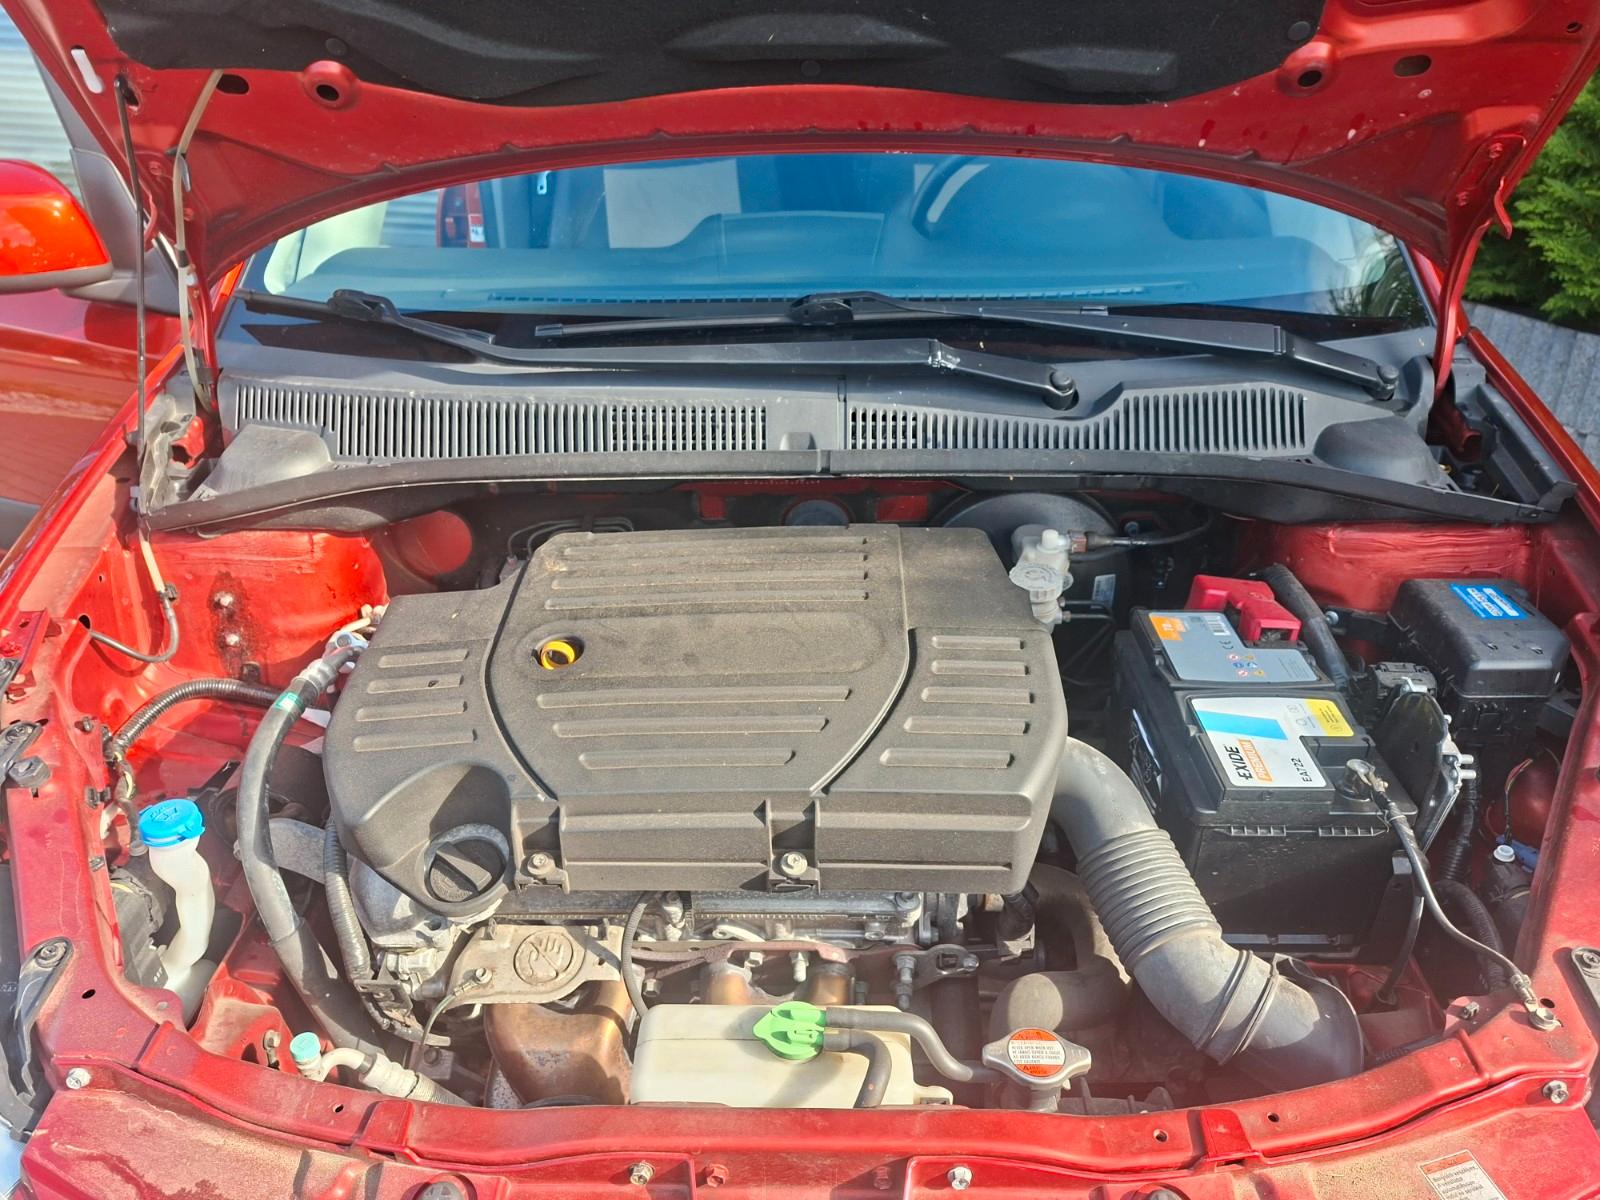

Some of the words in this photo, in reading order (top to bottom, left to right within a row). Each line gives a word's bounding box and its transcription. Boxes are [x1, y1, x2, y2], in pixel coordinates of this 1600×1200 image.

[1225, 745, 1253, 780] EXIDE
[1242, 740, 1269, 780] PREMIUM
[1291, 757, 1312, 782] EA722
